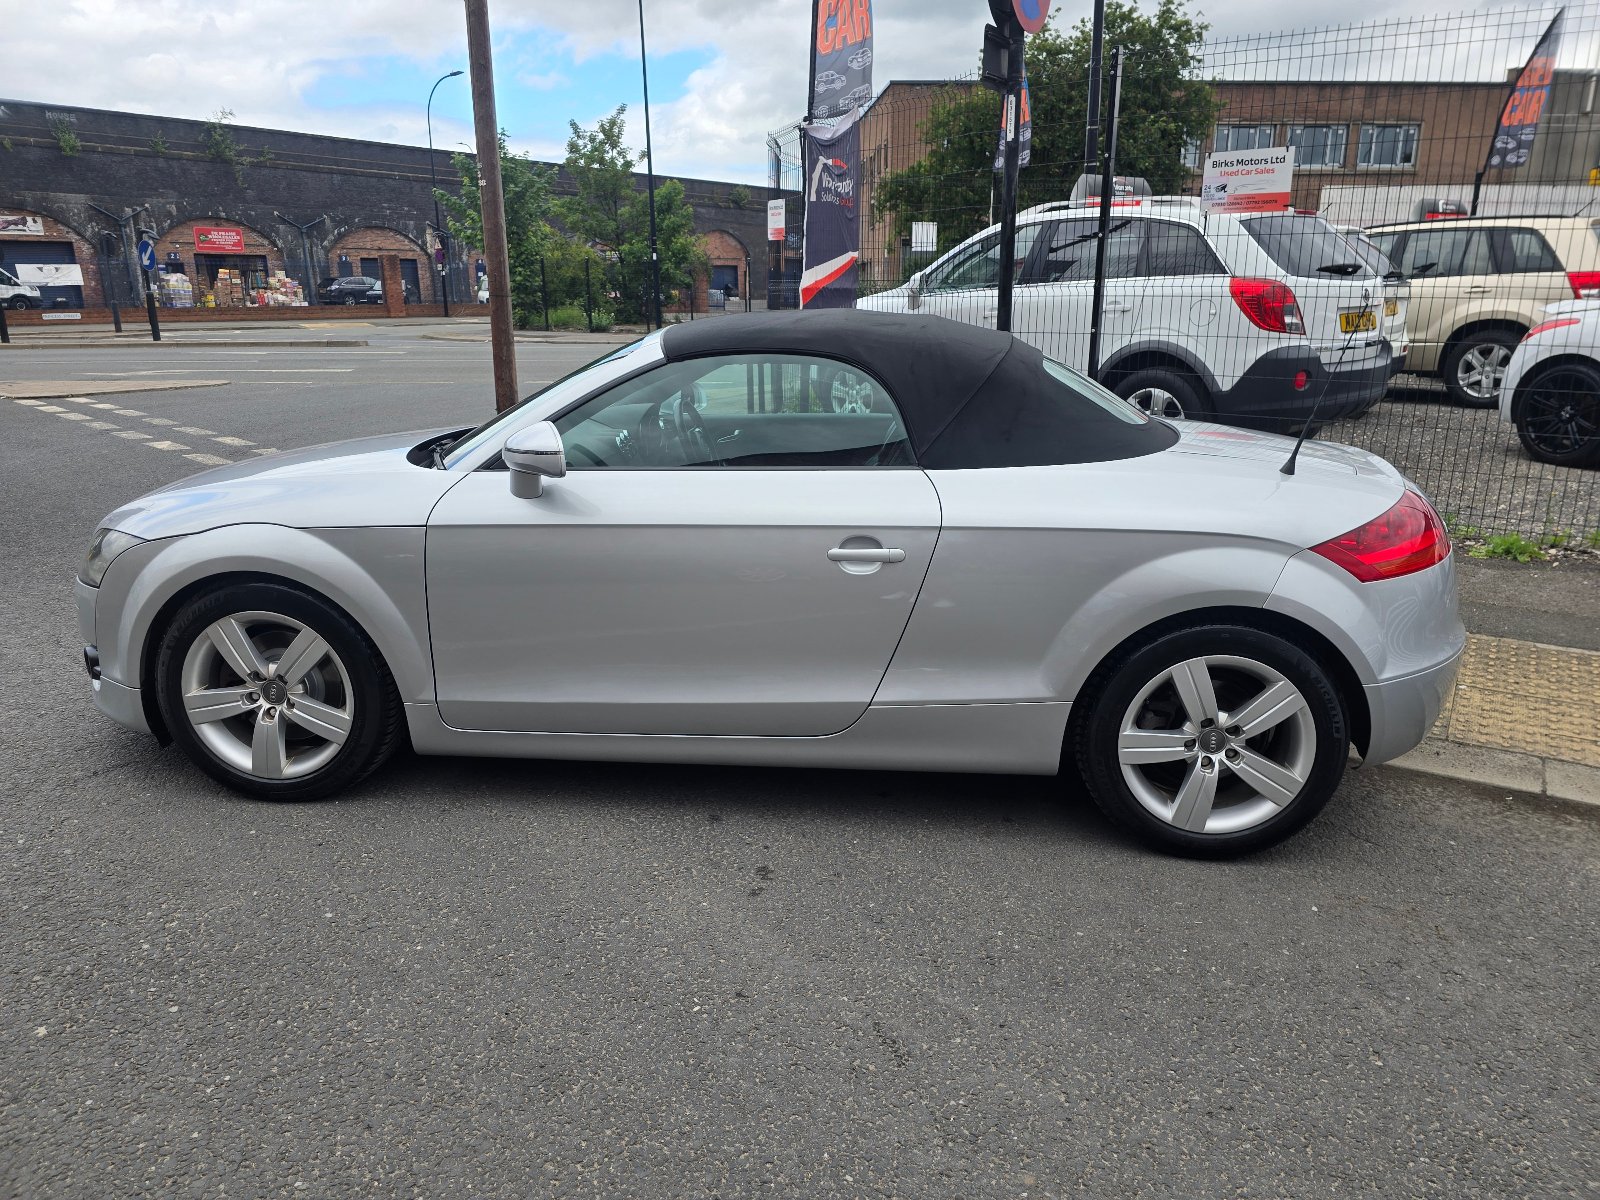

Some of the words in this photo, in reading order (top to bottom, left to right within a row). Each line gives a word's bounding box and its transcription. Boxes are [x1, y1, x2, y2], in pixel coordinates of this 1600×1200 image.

[817, 0, 870, 55] CAR
[1502, 90, 1546, 127] CAR
[1212, 160, 1235, 169] Birks
[1236, 157, 1269, 167] Motors
[1270, 155, 1286, 164] Ltd
[1220, 169, 1239, 177] Used
[1240, 168, 1254, 176] Car
[1254, 167, 1275, 175] Sales
